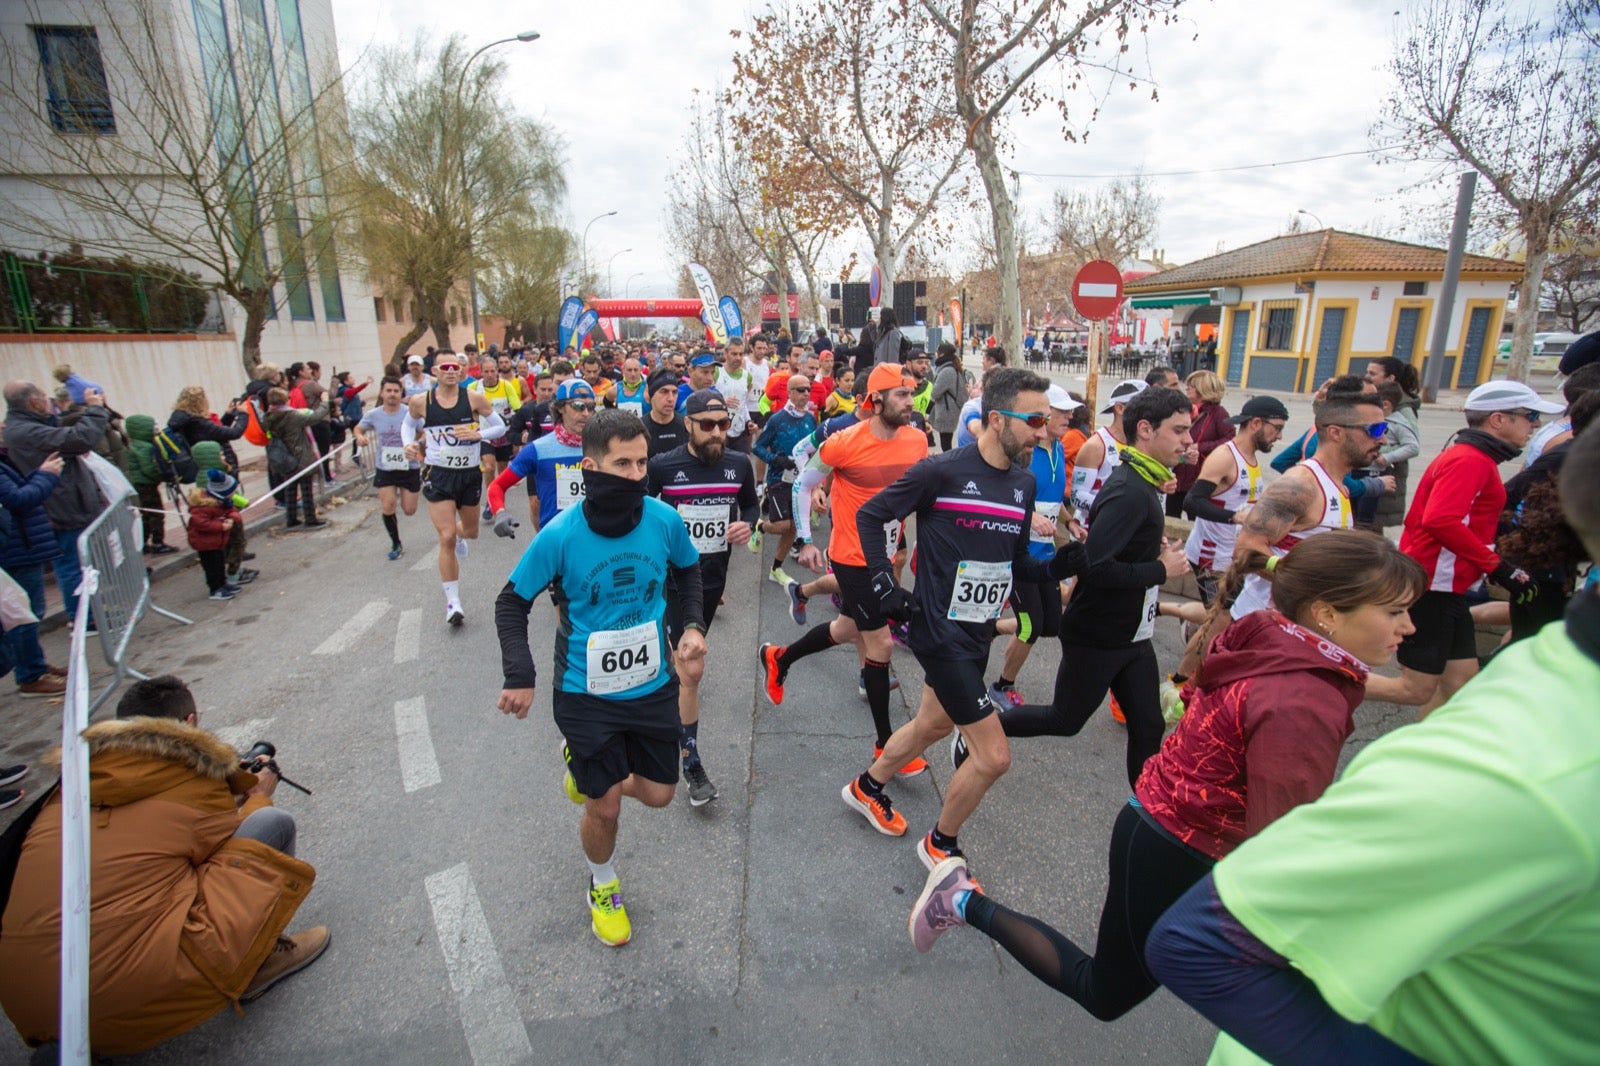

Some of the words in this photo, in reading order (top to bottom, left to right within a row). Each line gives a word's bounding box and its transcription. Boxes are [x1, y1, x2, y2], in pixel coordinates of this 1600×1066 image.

[386, 454, 404, 462] 546
[446, 456, 470, 467] 732
[957, 581, 1009, 604] 3067
[601, 644, 649, 673] 604
